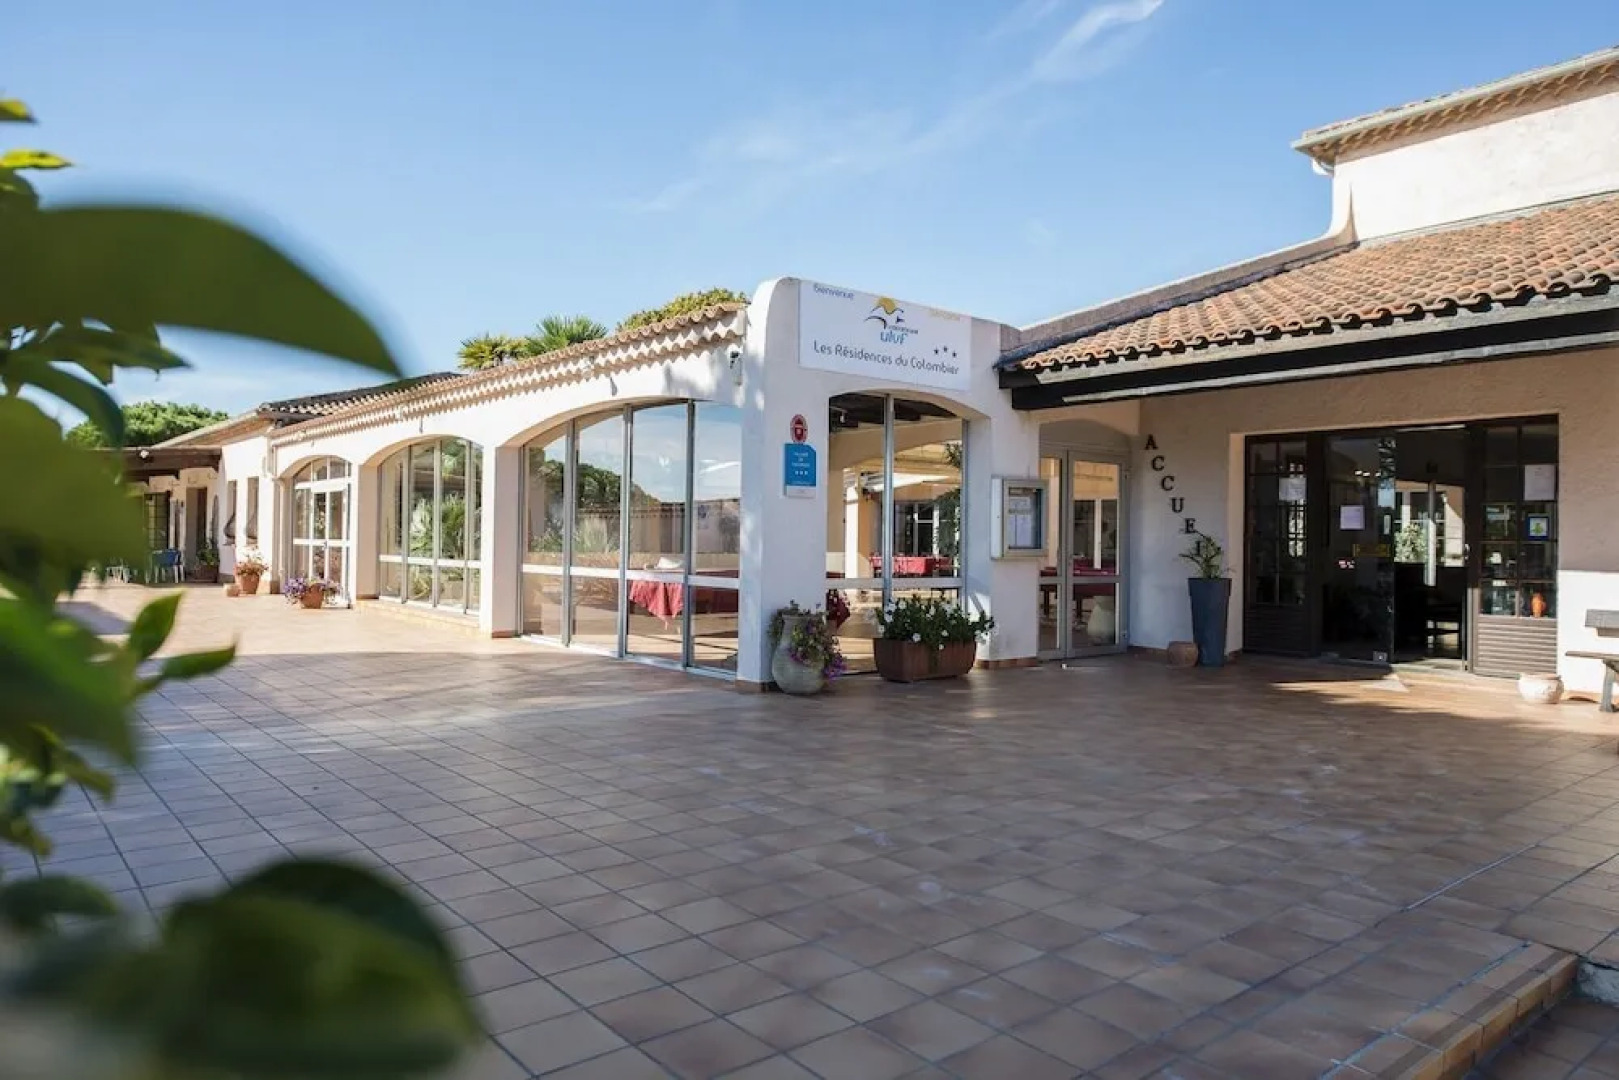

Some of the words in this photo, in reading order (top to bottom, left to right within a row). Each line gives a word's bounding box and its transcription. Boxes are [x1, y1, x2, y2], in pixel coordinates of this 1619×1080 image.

[813, 339, 832, 355] Les
[835, 344, 892, 365] Résidences
[895, 355, 908, 367] du
[910, 356, 959, 375] Colombier
[1145, 433, 1203, 557] ACCUEI
